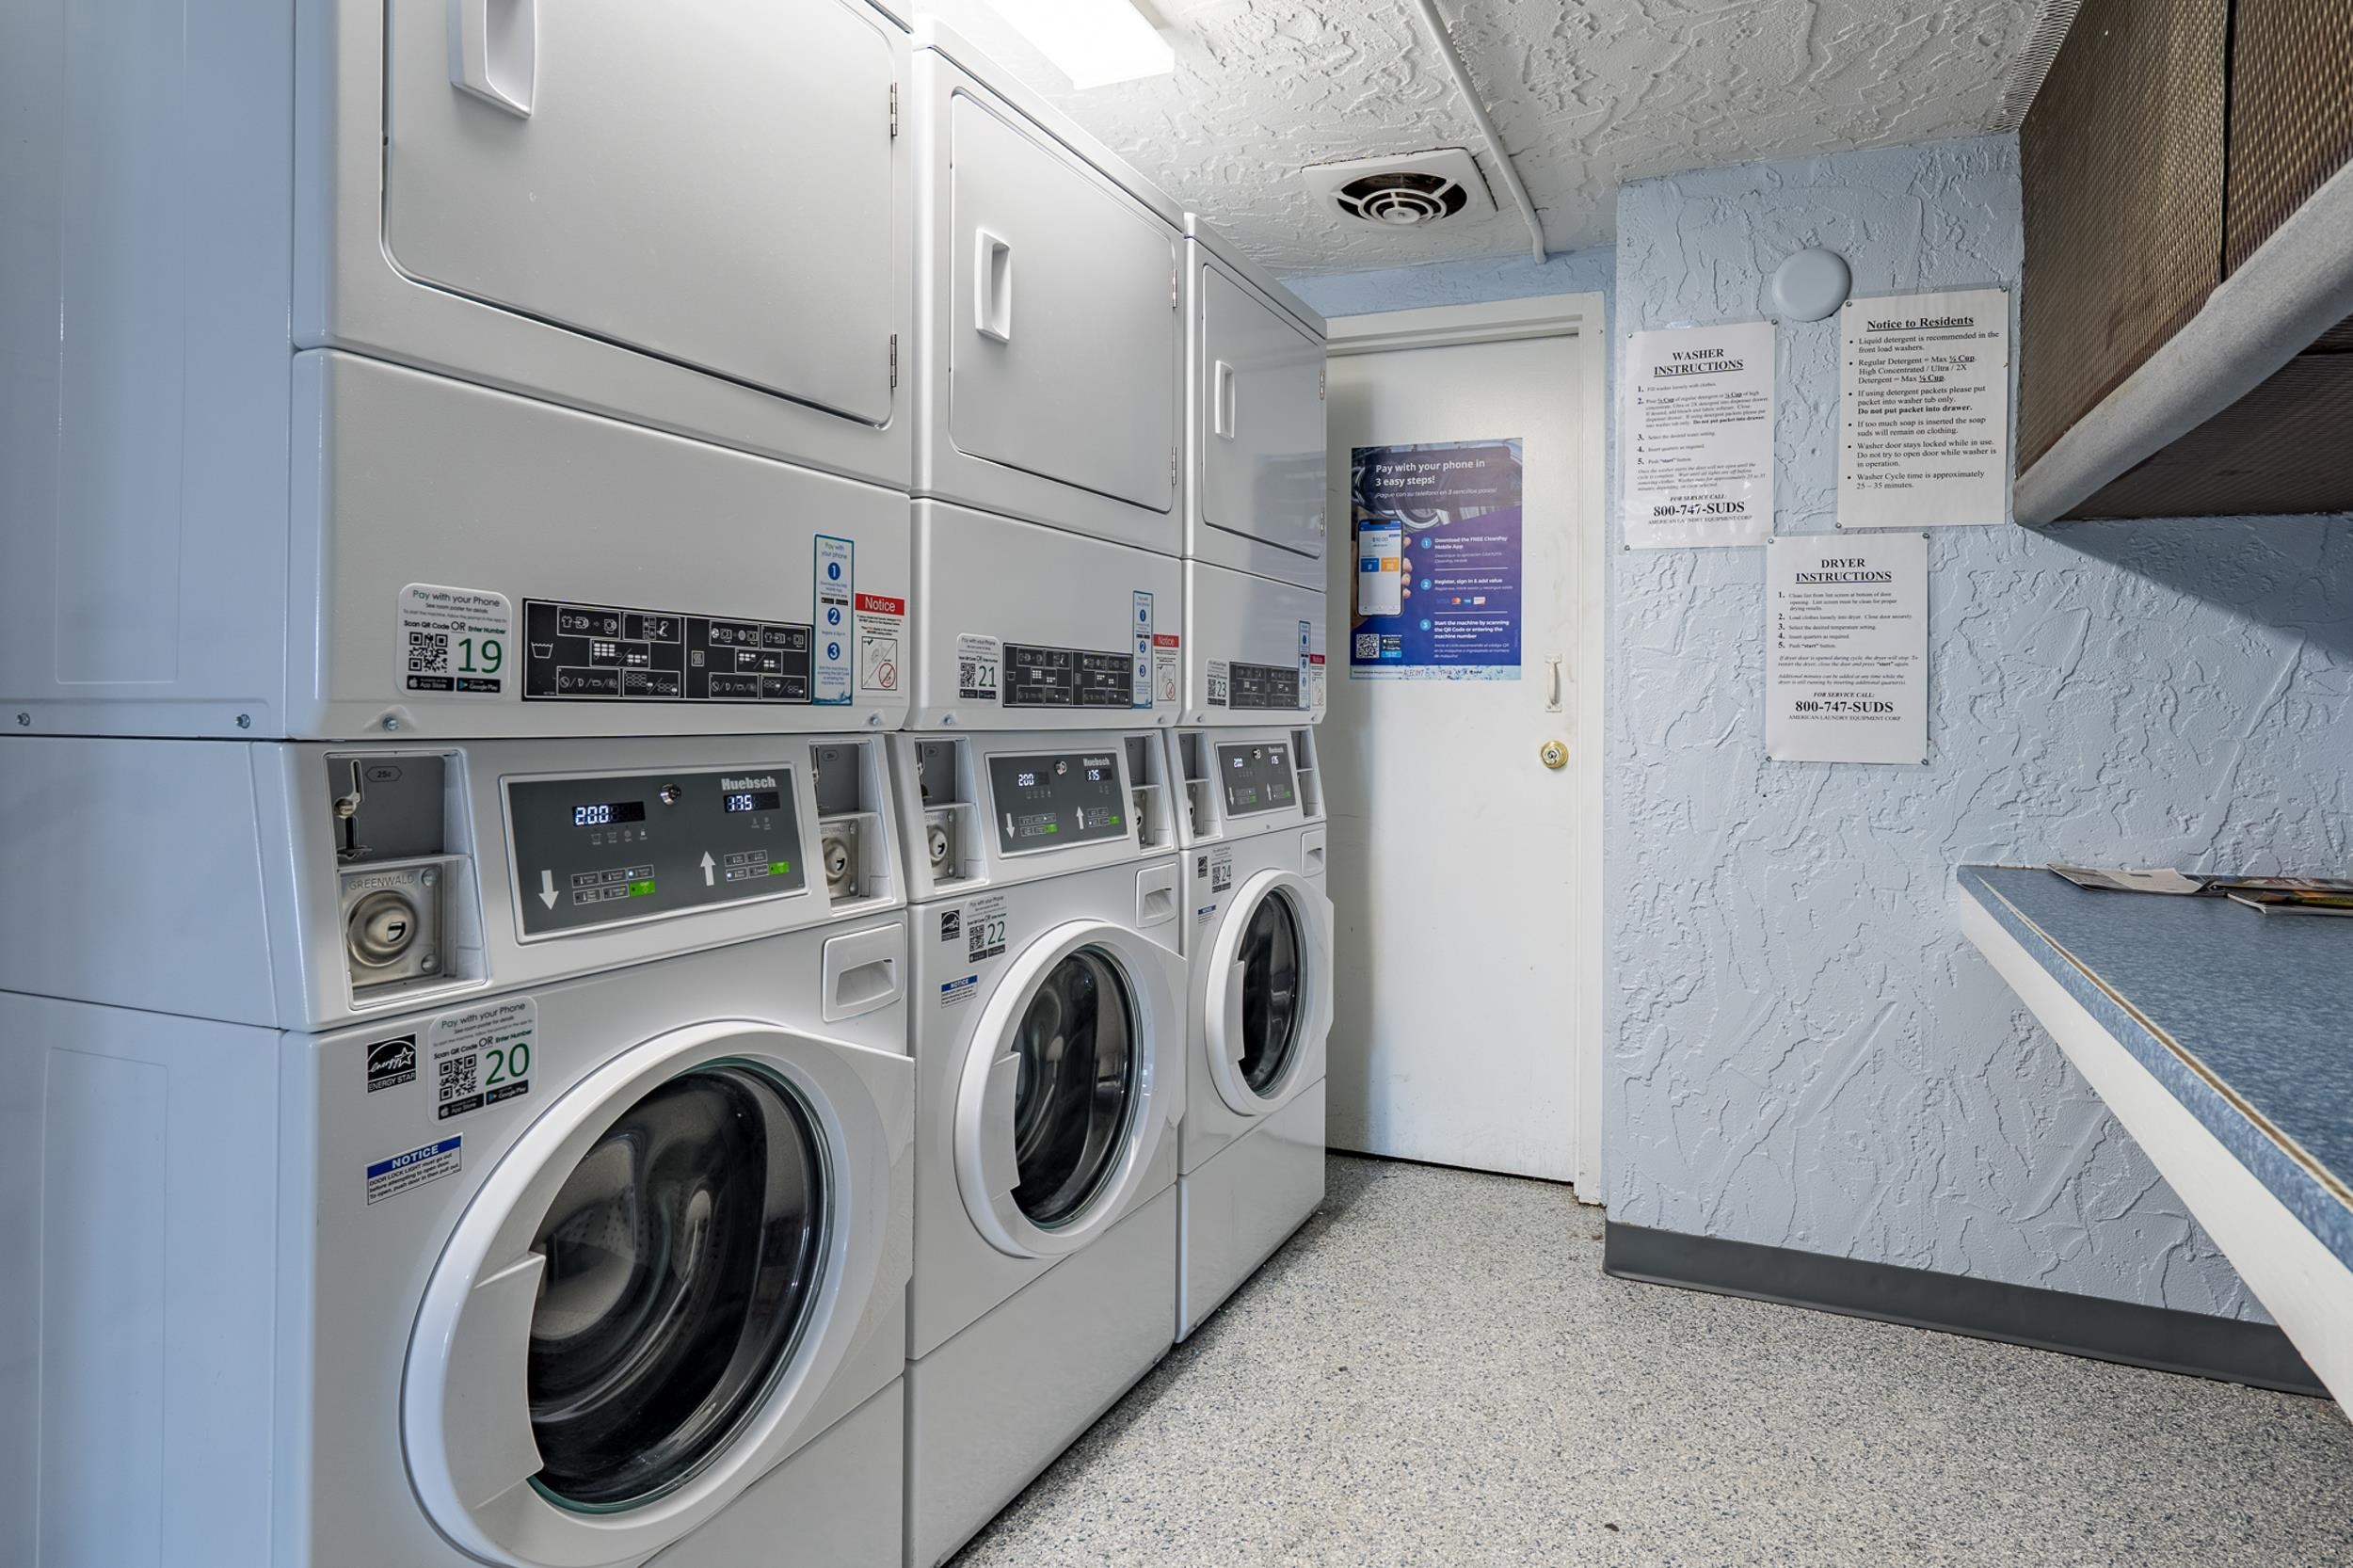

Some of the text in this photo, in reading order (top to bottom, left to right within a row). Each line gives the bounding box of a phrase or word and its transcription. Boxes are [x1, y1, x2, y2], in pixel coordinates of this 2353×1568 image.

[1867, 316, 1975, 330] Notice to Residents
[1884, 336, 1916, 344] detergent
[1926, 333, 1977, 342] recommended
[1673, 349, 1724, 360] WASHER
[1654, 360, 1743, 376] INSTRUCTIONS
[1888, 358, 1922, 366] Detergent
[1860, 368, 1876, 376] High
[1878, 366, 1925, 375] Concentrated
[1886, 388, 1918, 396] detergent
[1921, 387, 1947, 395] packets
[1949, 386, 1972, 394] please
[1858, 398, 1881, 408] packet
[1938, 395, 1956, 404] only.
[1899, 406, 1924, 414] packet
[1927, 427, 1959, 436] clothing.
[1376, 459, 1485, 474] Pay with your phone in
[1865, 460, 1900, 469] operation.
[1376, 475, 1435, 488] 3 easy steps!
[1885, 472, 1906, 481] Cycle
[1933, 470, 1985, 480] approximately
[1654, 502, 1745, 517] 800-747-SUDS
[1821, 558, 1865, 568] DRYER
[832, 566, 837, 577] 1
[1796, 571, 1892, 584] INSTRUCTIONS
[413, 589, 500, 607] Pay with your Phone
[865, 597, 896, 612] Notice
[831, 611, 837, 622] 2
[451, 621, 466, 632] OR
[1158, 636, 1175, 646] Notice
[458, 638, 503, 674] 19
[830, 646, 837, 657] 3
[979, 665, 997, 688] 21
[1217, 681, 1227, 698] 23
[1796, 701, 1894, 712] 800-747-SUDS
[1083, 758, 1111, 767] Huebsch
[721, 776, 776, 791] Huebsch
[1018, 774, 1034, 787] 200
[728, 795, 753, 811] 175
[576, 806, 609, 825] 200
[1222, 865, 1231, 882] 24
[348, 873, 415, 890] GREENWALD
[987, 920, 1005, 946] 22
[441, 1003, 526, 1030] Pay with your Phone
[371, 1060, 401, 1072] energy
[486, 1043, 530, 1086] 20
[369, 1072, 416, 1092] ENERGY STAR
[392, 1145, 440, 1169] NOTICE
